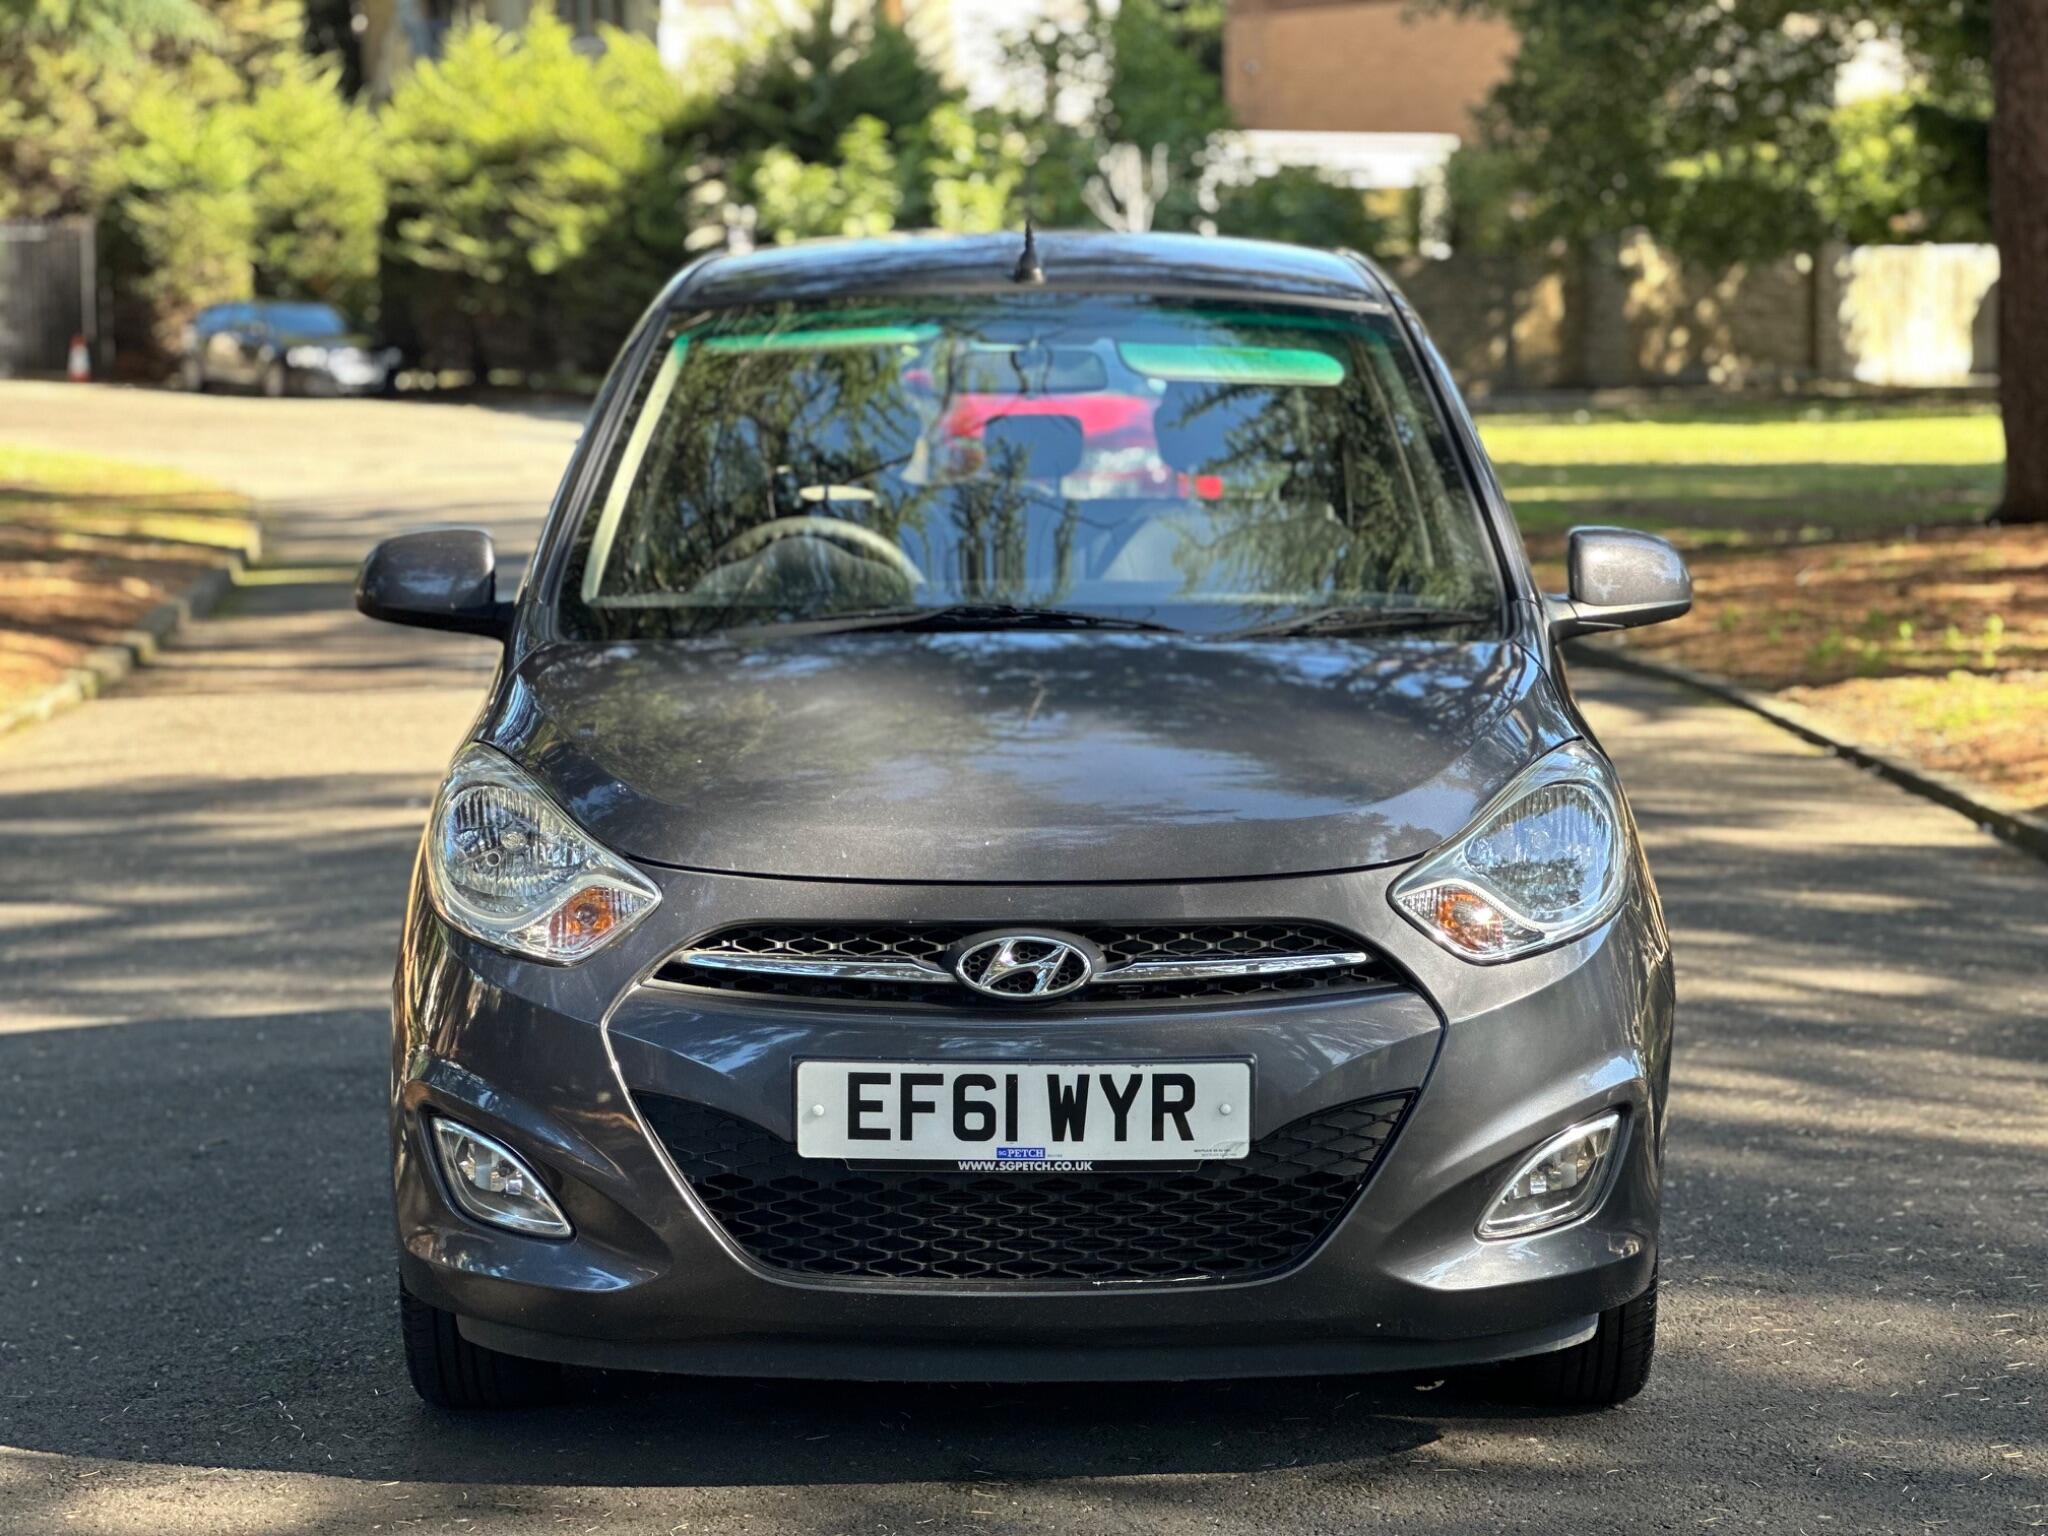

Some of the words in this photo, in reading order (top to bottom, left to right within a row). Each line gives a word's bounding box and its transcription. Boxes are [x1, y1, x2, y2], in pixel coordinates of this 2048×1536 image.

[847, 1072, 1019, 1143] EF61
[1047, 1073, 1196, 1142] WYR
[1008, 1149, 1044, 1158] PETCH
[958, 1161, 1093, 1171] WWW.SGPETCH.CO.UK
